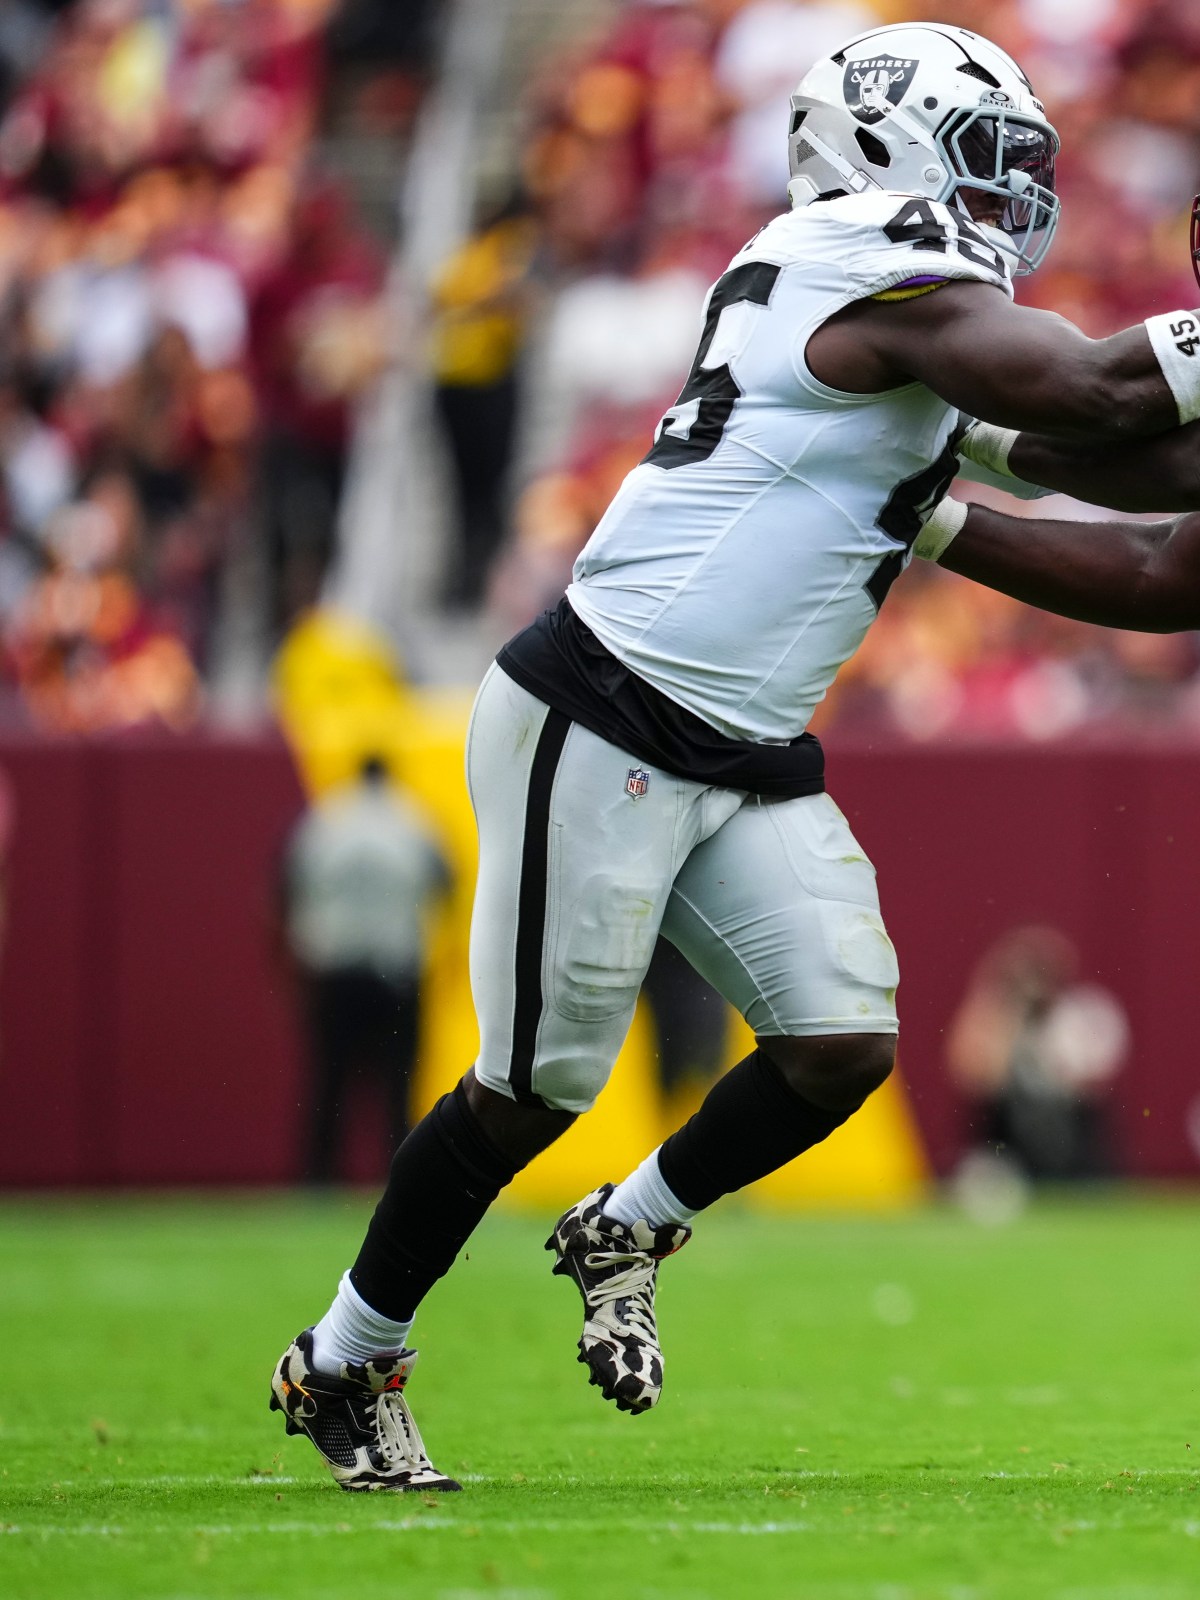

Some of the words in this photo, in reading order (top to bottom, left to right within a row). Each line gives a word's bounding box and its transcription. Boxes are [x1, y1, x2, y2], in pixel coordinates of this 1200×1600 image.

[852, 60, 912, 69] RAIDERS
[983, 98, 1015, 110] OAKLEY
[1169, 318, 1200, 357] 45
[629, 779, 645, 794] NFL
